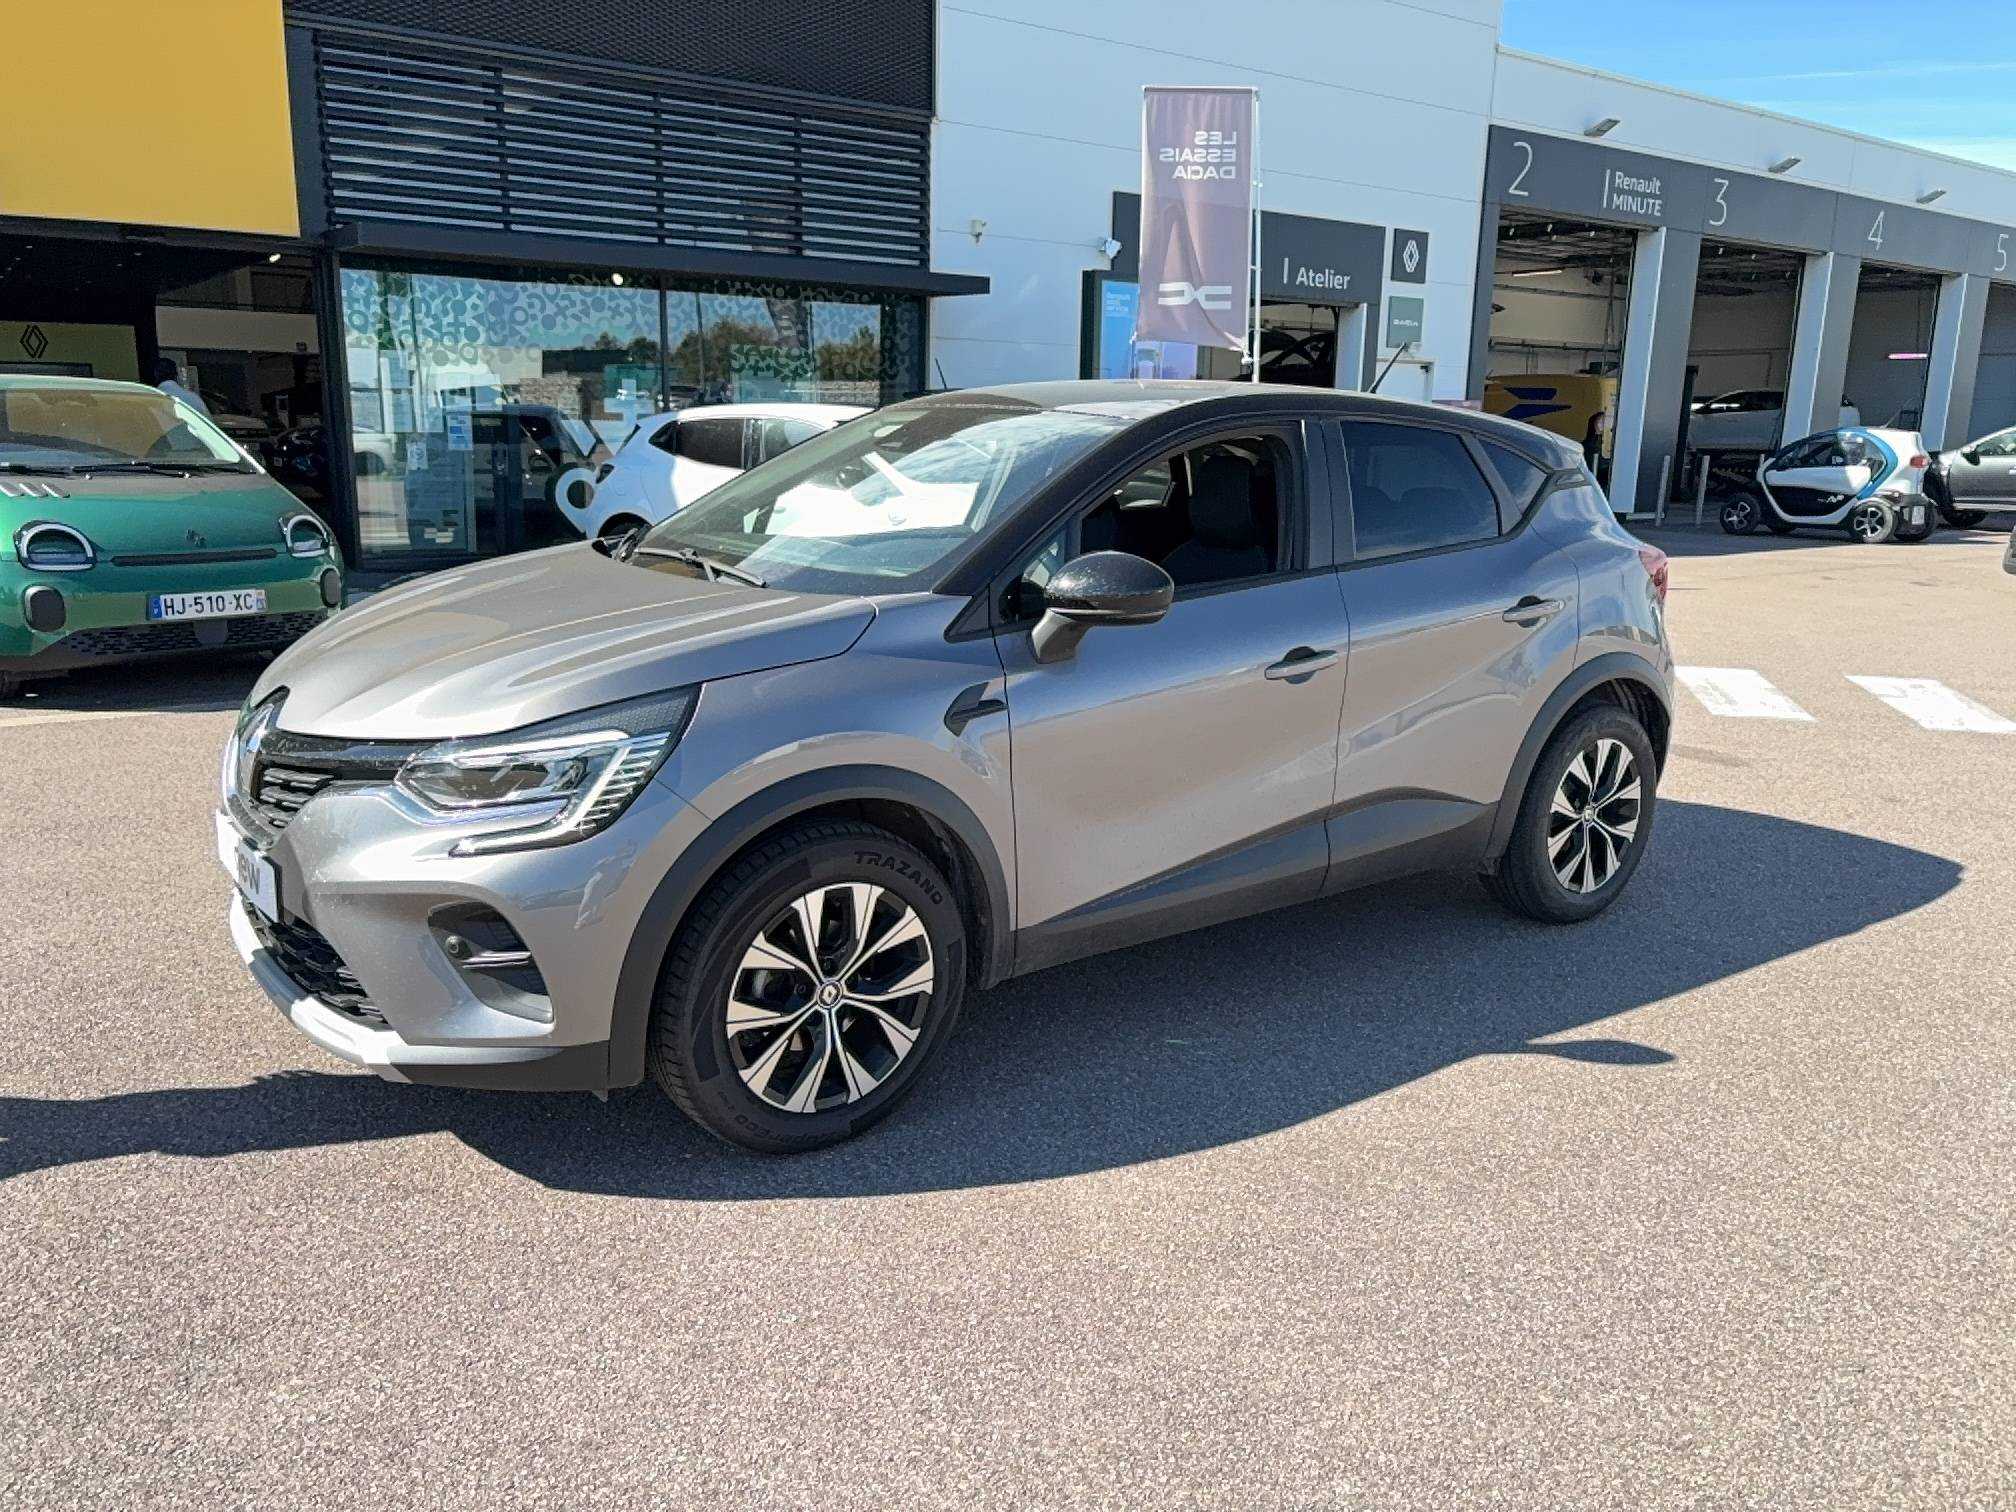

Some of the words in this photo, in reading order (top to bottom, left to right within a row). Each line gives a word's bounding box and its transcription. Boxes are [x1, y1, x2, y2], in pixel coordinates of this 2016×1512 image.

[1507, 141, 1533, 197] 2
[1614, 170, 1662, 196] Renault
[1611, 192, 1664, 217] MINUTE
[1708, 177, 1730, 226] 3
[1867, 209, 1885, 251] 4
[1993, 233, 2009, 272] 5
[1295, 266, 1352, 291] Atelier
[163, 593, 253, 617] HJ-510-XC
[853, 850, 944, 905] TRAZANO
